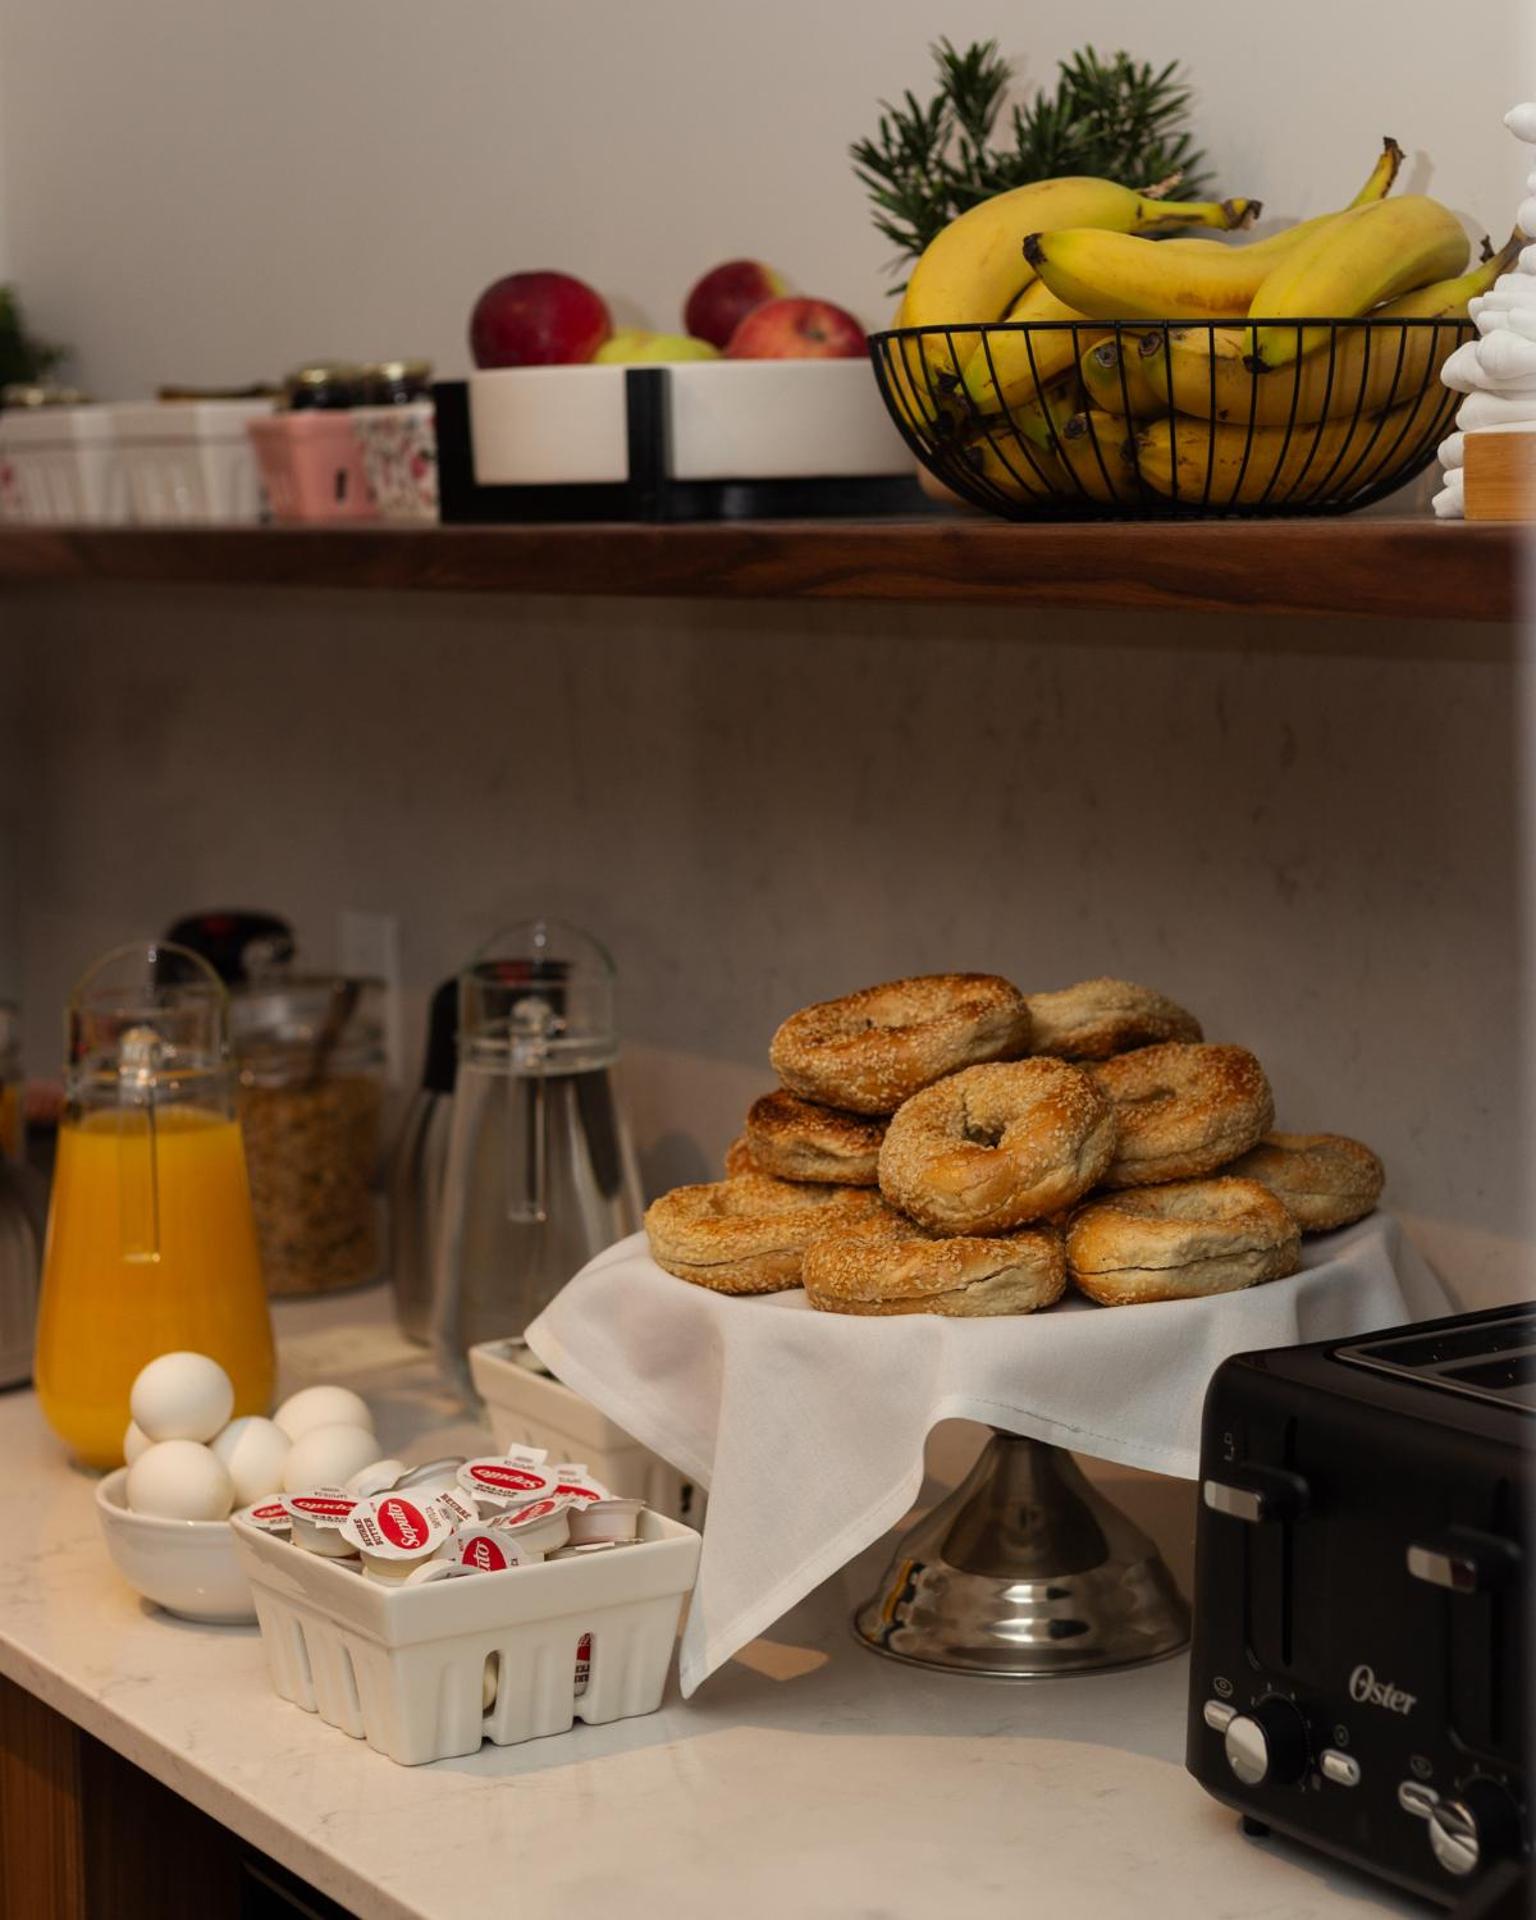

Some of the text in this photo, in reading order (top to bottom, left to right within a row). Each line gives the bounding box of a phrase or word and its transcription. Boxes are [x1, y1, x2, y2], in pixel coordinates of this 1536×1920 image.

[472, 1467, 543, 1490] Saputo
[296, 1500, 352, 1512] aputo
[387, 1501, 421, 1547] Saputo
[473, 1540, 491, 1572] uto
[1349, 1664, 1417, 1715] Oster
